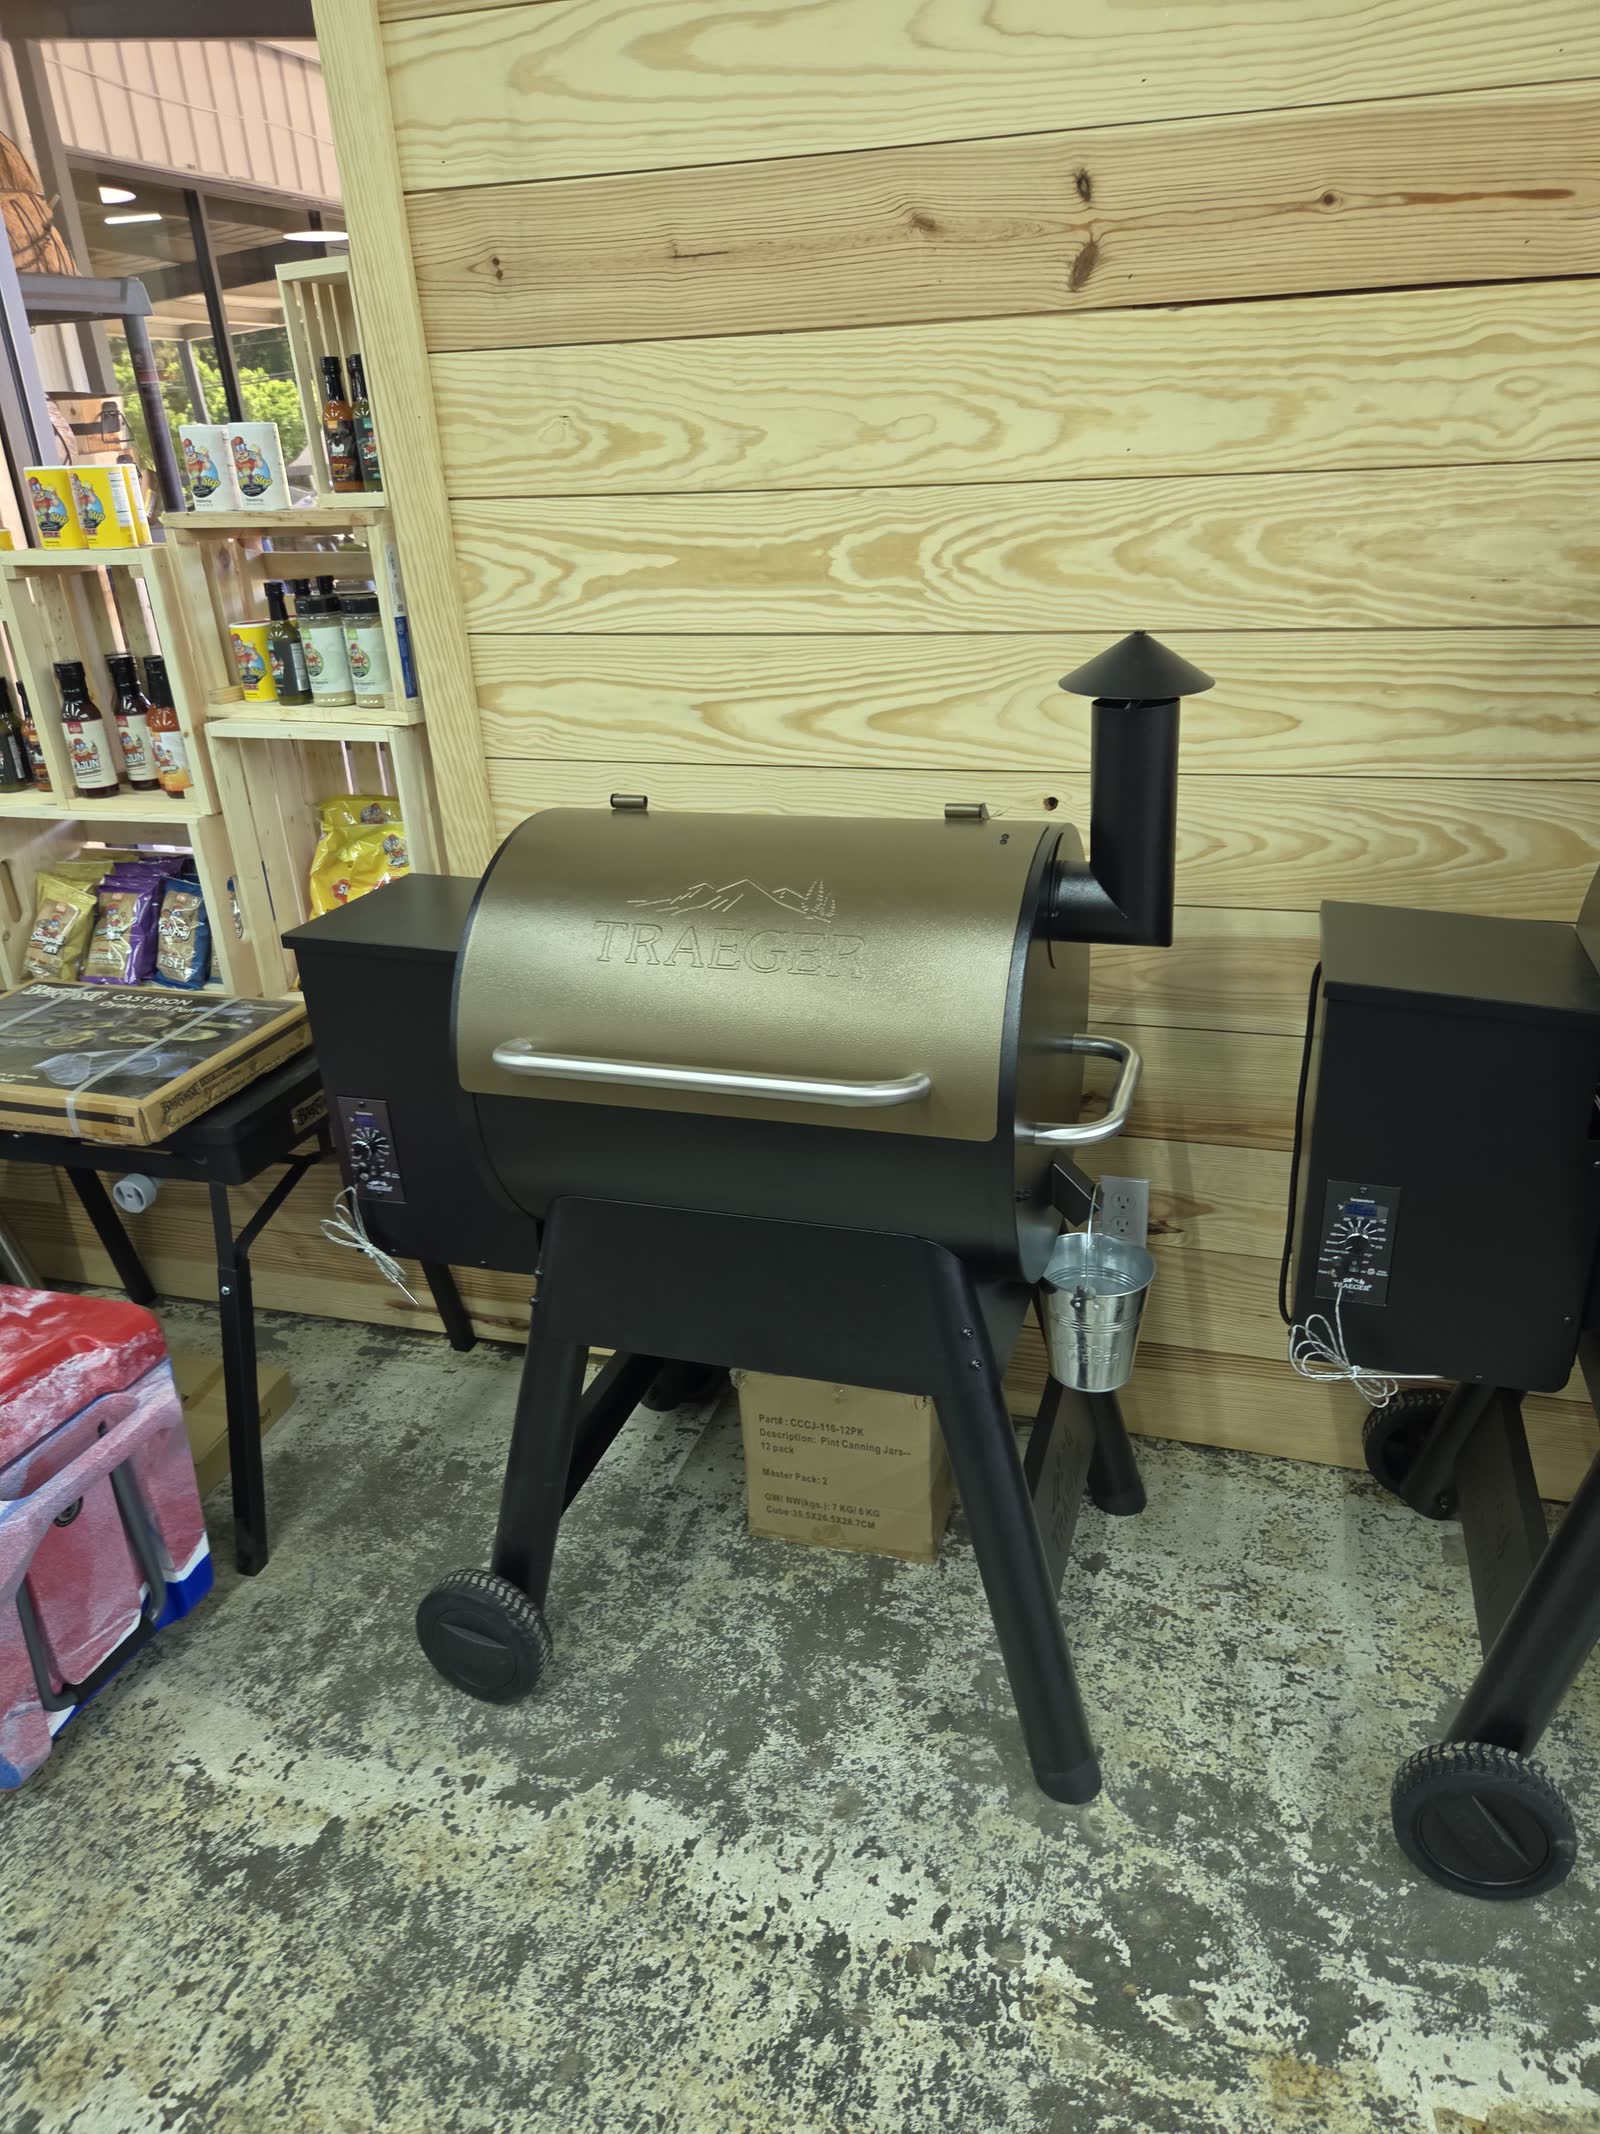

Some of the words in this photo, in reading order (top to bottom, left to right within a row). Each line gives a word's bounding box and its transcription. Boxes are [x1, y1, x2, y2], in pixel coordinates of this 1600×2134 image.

[594, 919, 867, 979] TRAEGER
[100, 1000, 143, 1009] Oyster
[141, 1003, 174, 1012] Grill
[112, 994, 153, 1004] CAST
[150, 997, 193, 1007] IRON
[760, 1427, 816, 1443] Description:
[820, 1436, 840, 1448] Pint
[841, 1440, 881, 1455] Canning
[760, 1441, 771, 1452] 12
[772, 1443, 794, 1455] pack
[762, 1467, 793, 1480] Master
[794, 1472, 820, 1484] Pack:
[821, 1476, 828, 1486] 2
[865, 1508, 880, 1519] KG
